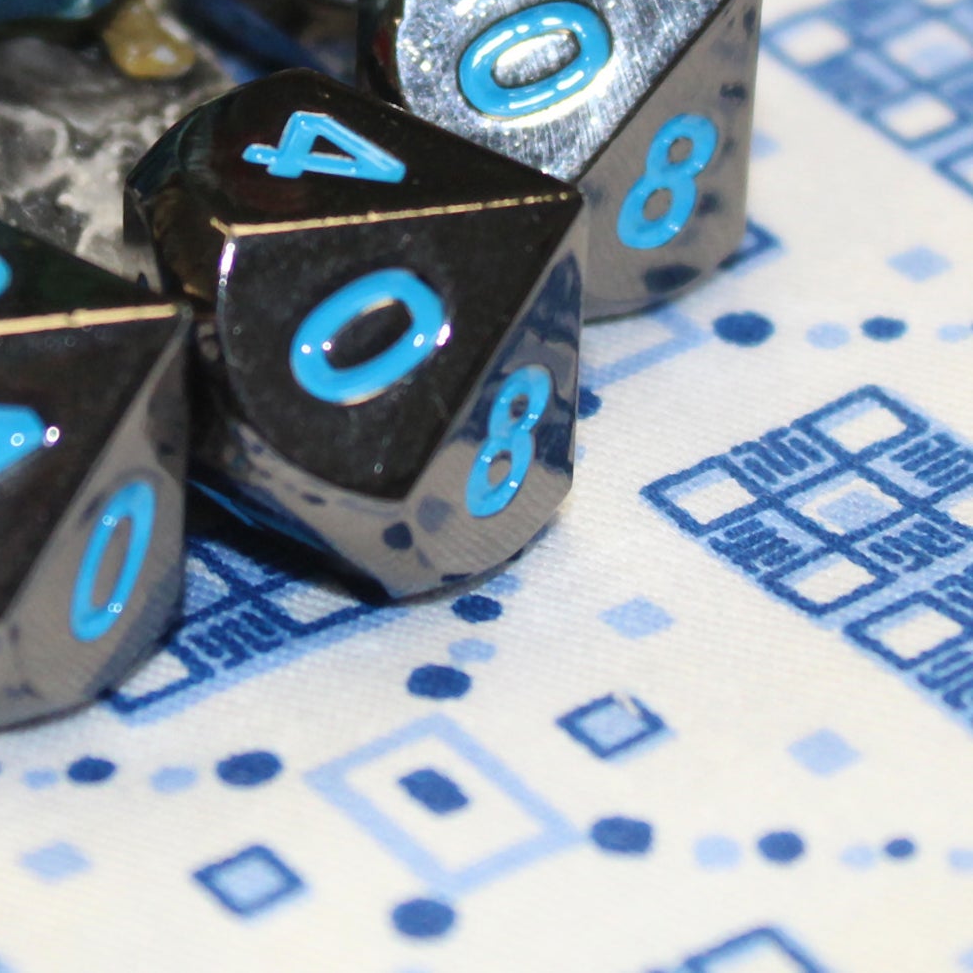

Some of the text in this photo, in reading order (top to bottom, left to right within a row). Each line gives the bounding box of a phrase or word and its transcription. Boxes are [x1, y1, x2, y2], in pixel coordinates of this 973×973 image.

[457, 0, 614, 119] 0
[242, 110, 407, 184] 4
[616, 112, 718, 249] 8
[289, 268, 448, 405] 0
[465, 364, 553, 518] 8
[69, 480, 157, 641] 0
